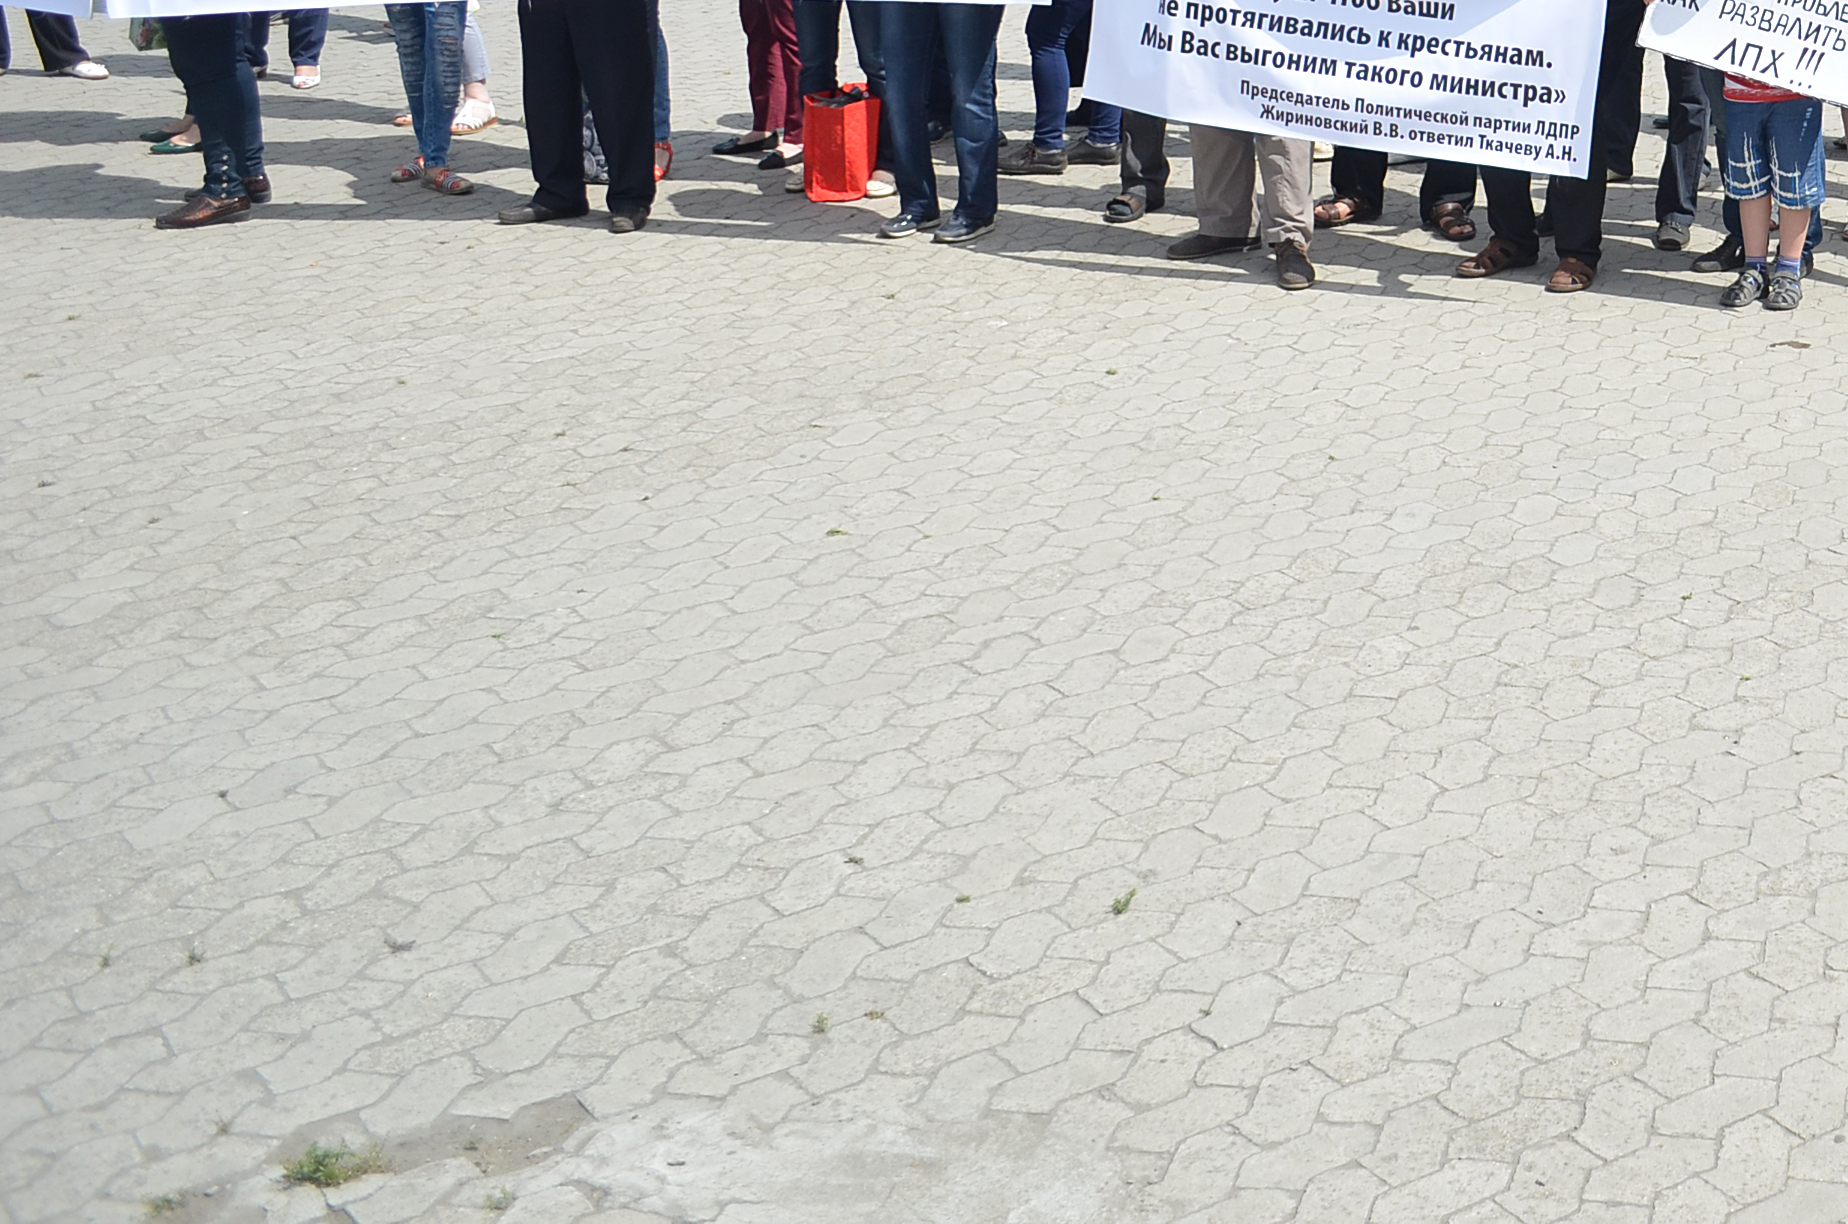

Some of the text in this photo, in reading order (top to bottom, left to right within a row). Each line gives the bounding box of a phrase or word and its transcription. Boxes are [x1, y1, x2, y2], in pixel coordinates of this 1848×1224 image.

[1140, 22, 1566, 108] Мы Вас выгоним такого министра»
[1185, 1, 1371, 46] протягивались
[1377, 29, 1392, 49] к
[1397, 32, 1554, 70] крестьянам.
[1713, 37, 1785, 79] ЛПХ
[1240, 79, 1580, 141] Председатель Политической партии ЛДПР
[1259, 103, 1578, 163] Жириновский В.В. ответил Ткачеву А.Н.
